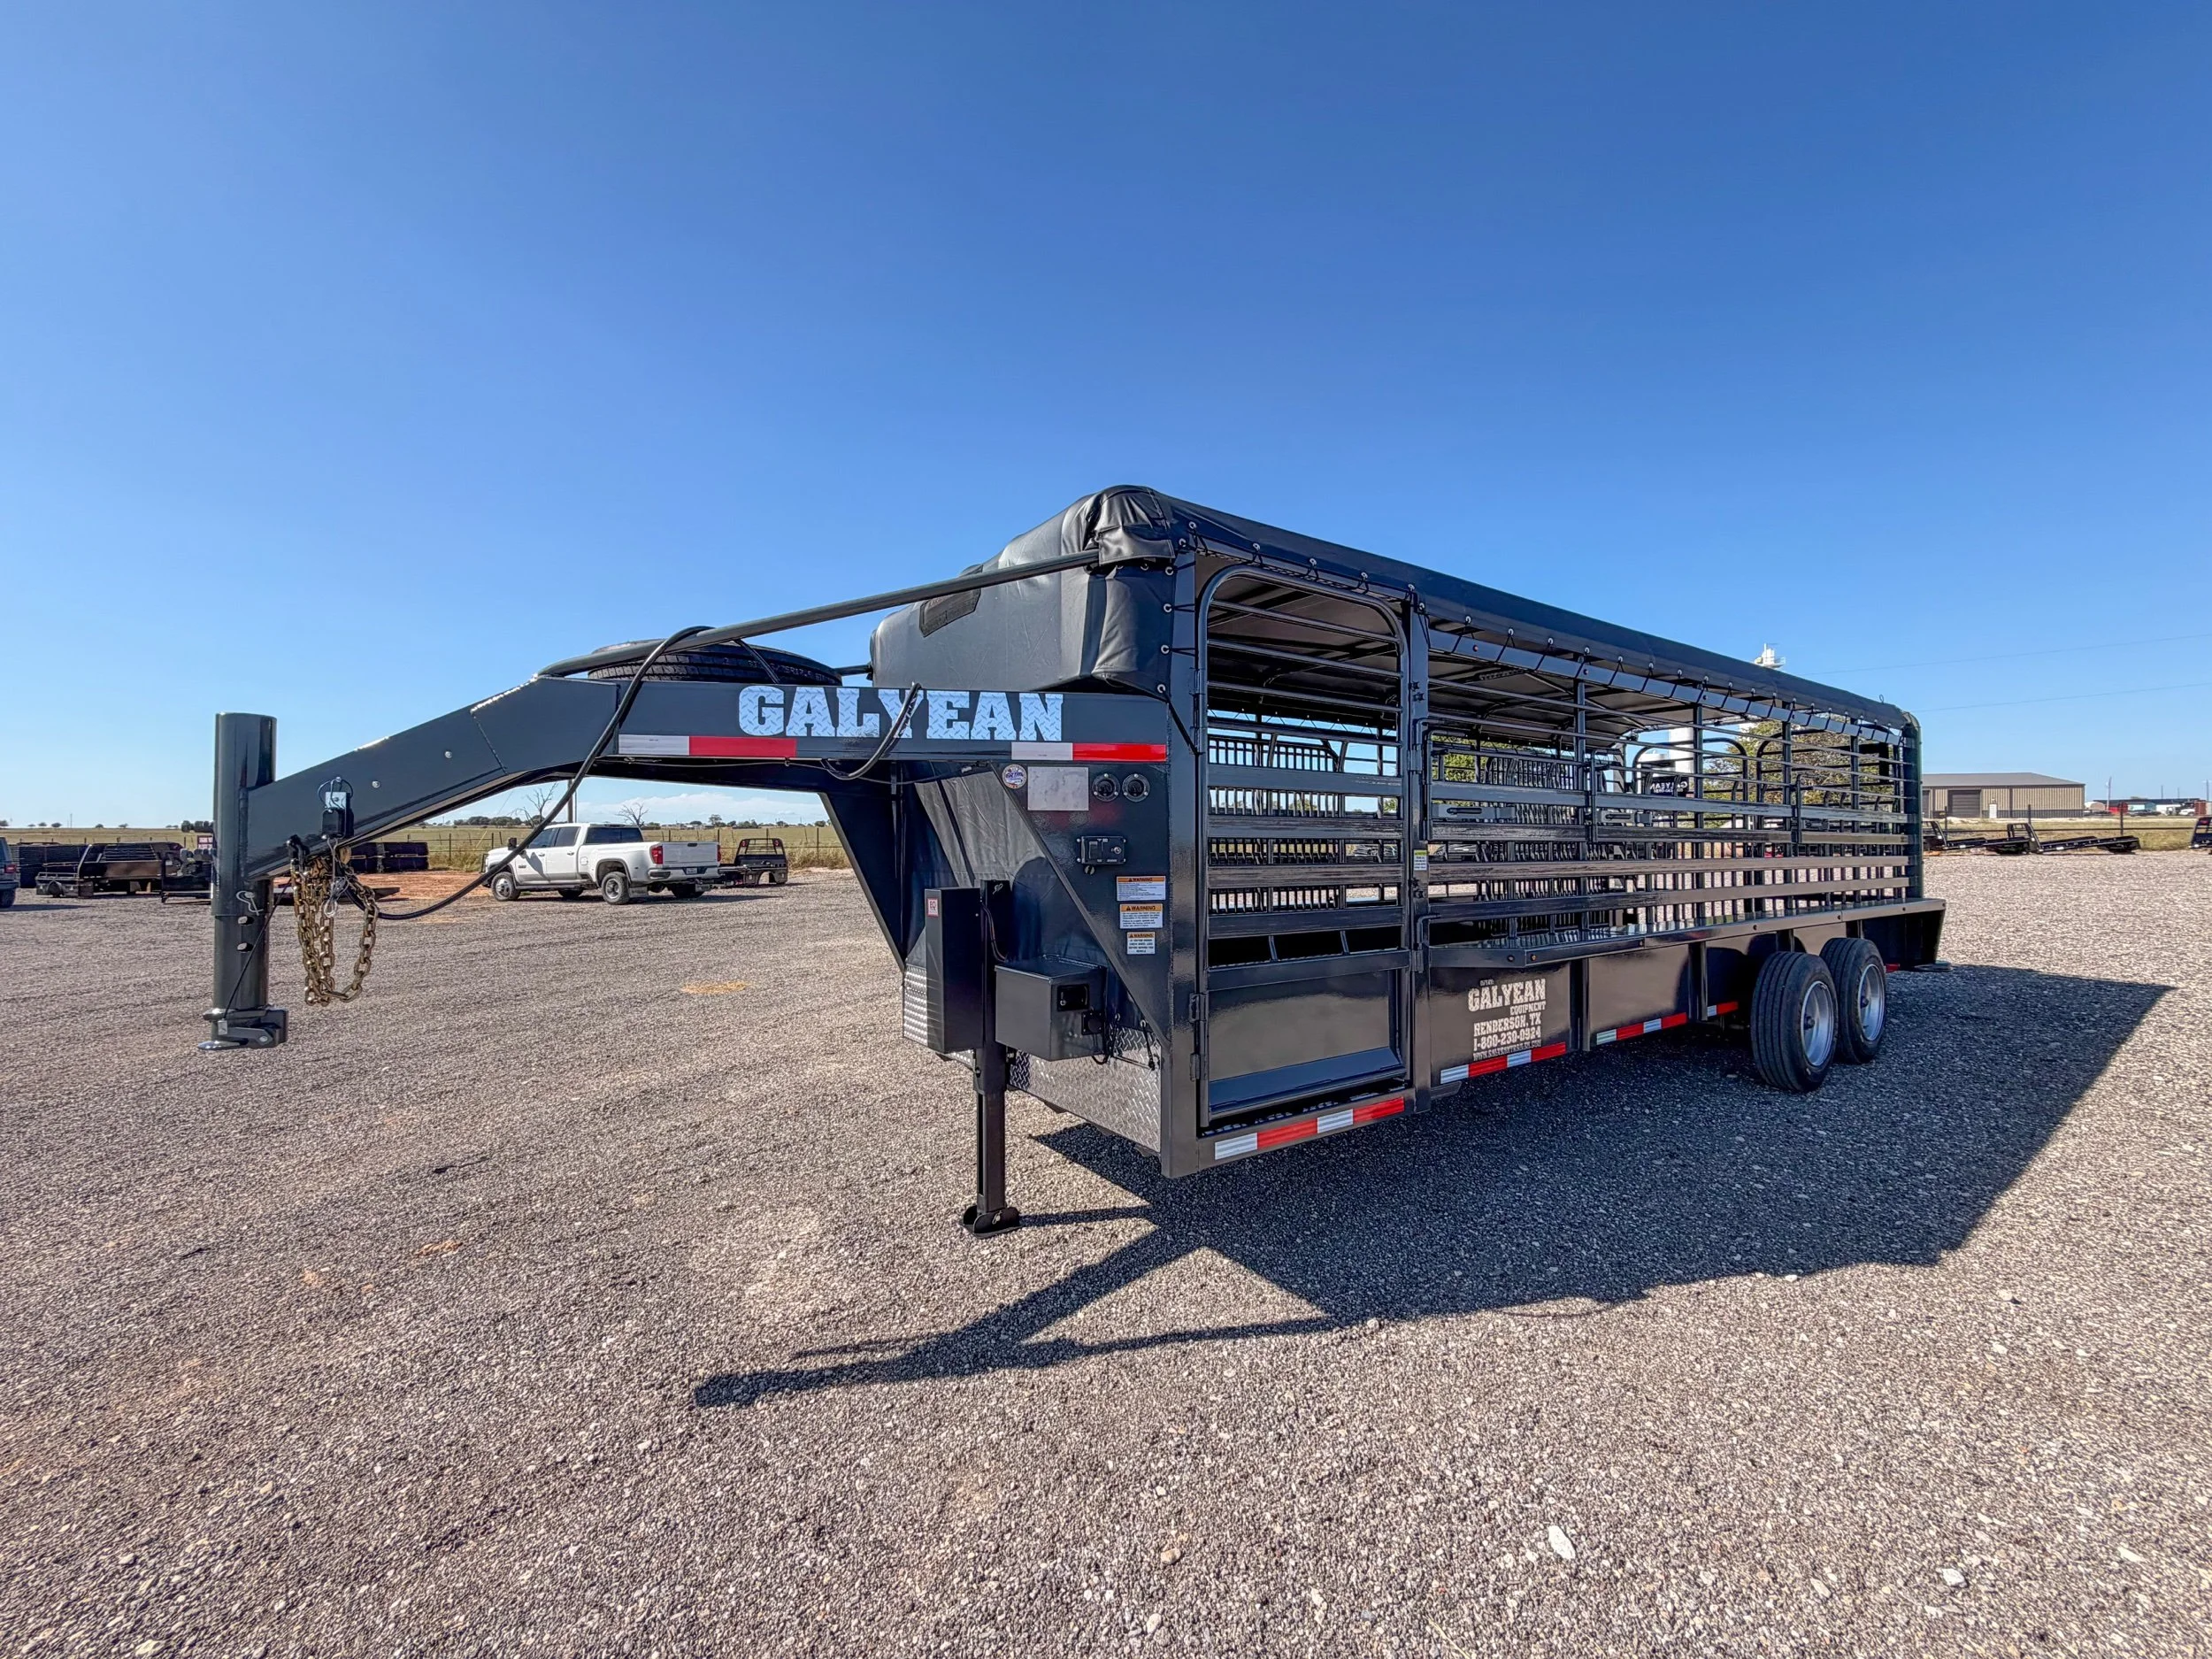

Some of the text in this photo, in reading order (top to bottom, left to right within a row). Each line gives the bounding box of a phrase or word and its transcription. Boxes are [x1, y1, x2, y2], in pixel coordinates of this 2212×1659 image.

[739, 685, 1063, 741] GALYEAN
[1468, 979, 1546, 1011] GALYEAN
[1509, 1001, 1546, 1016] EQUIPMENT
[1529, 1011, 1541, 1025] TX
